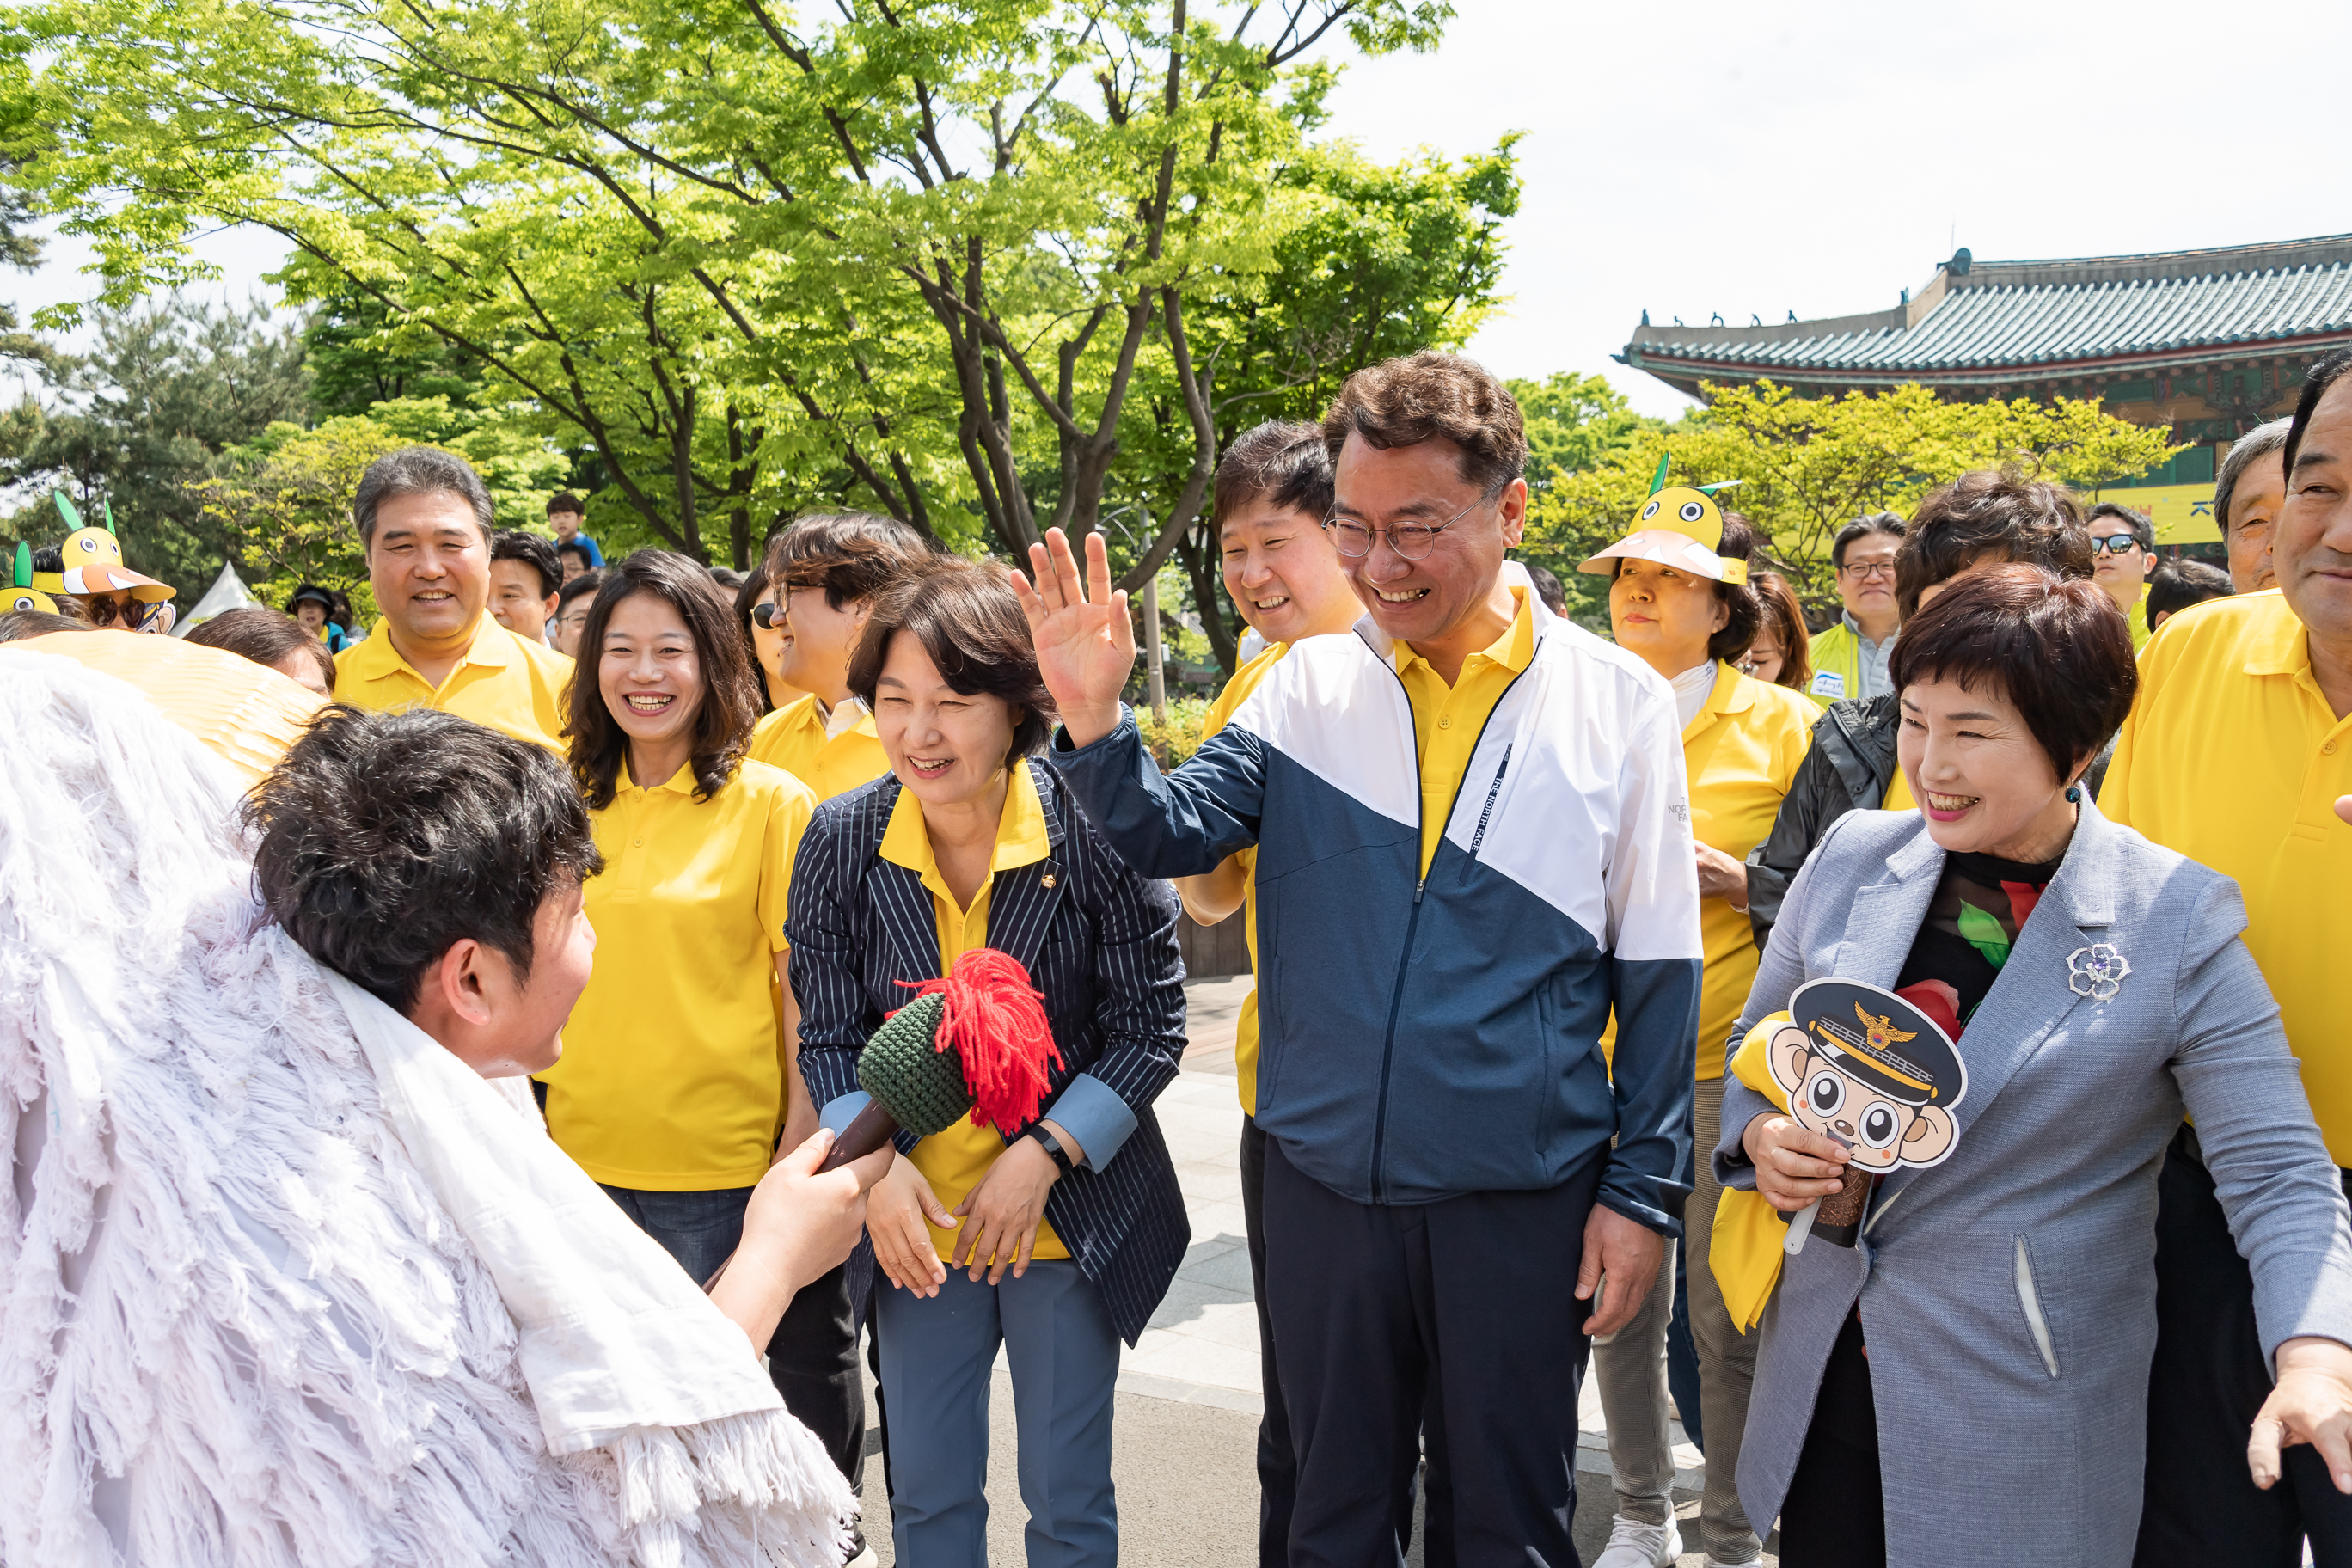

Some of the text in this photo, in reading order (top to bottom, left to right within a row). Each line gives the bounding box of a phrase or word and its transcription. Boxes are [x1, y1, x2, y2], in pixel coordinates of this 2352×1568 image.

[1471, 776, 1504, 852] THE NORTH FACE
